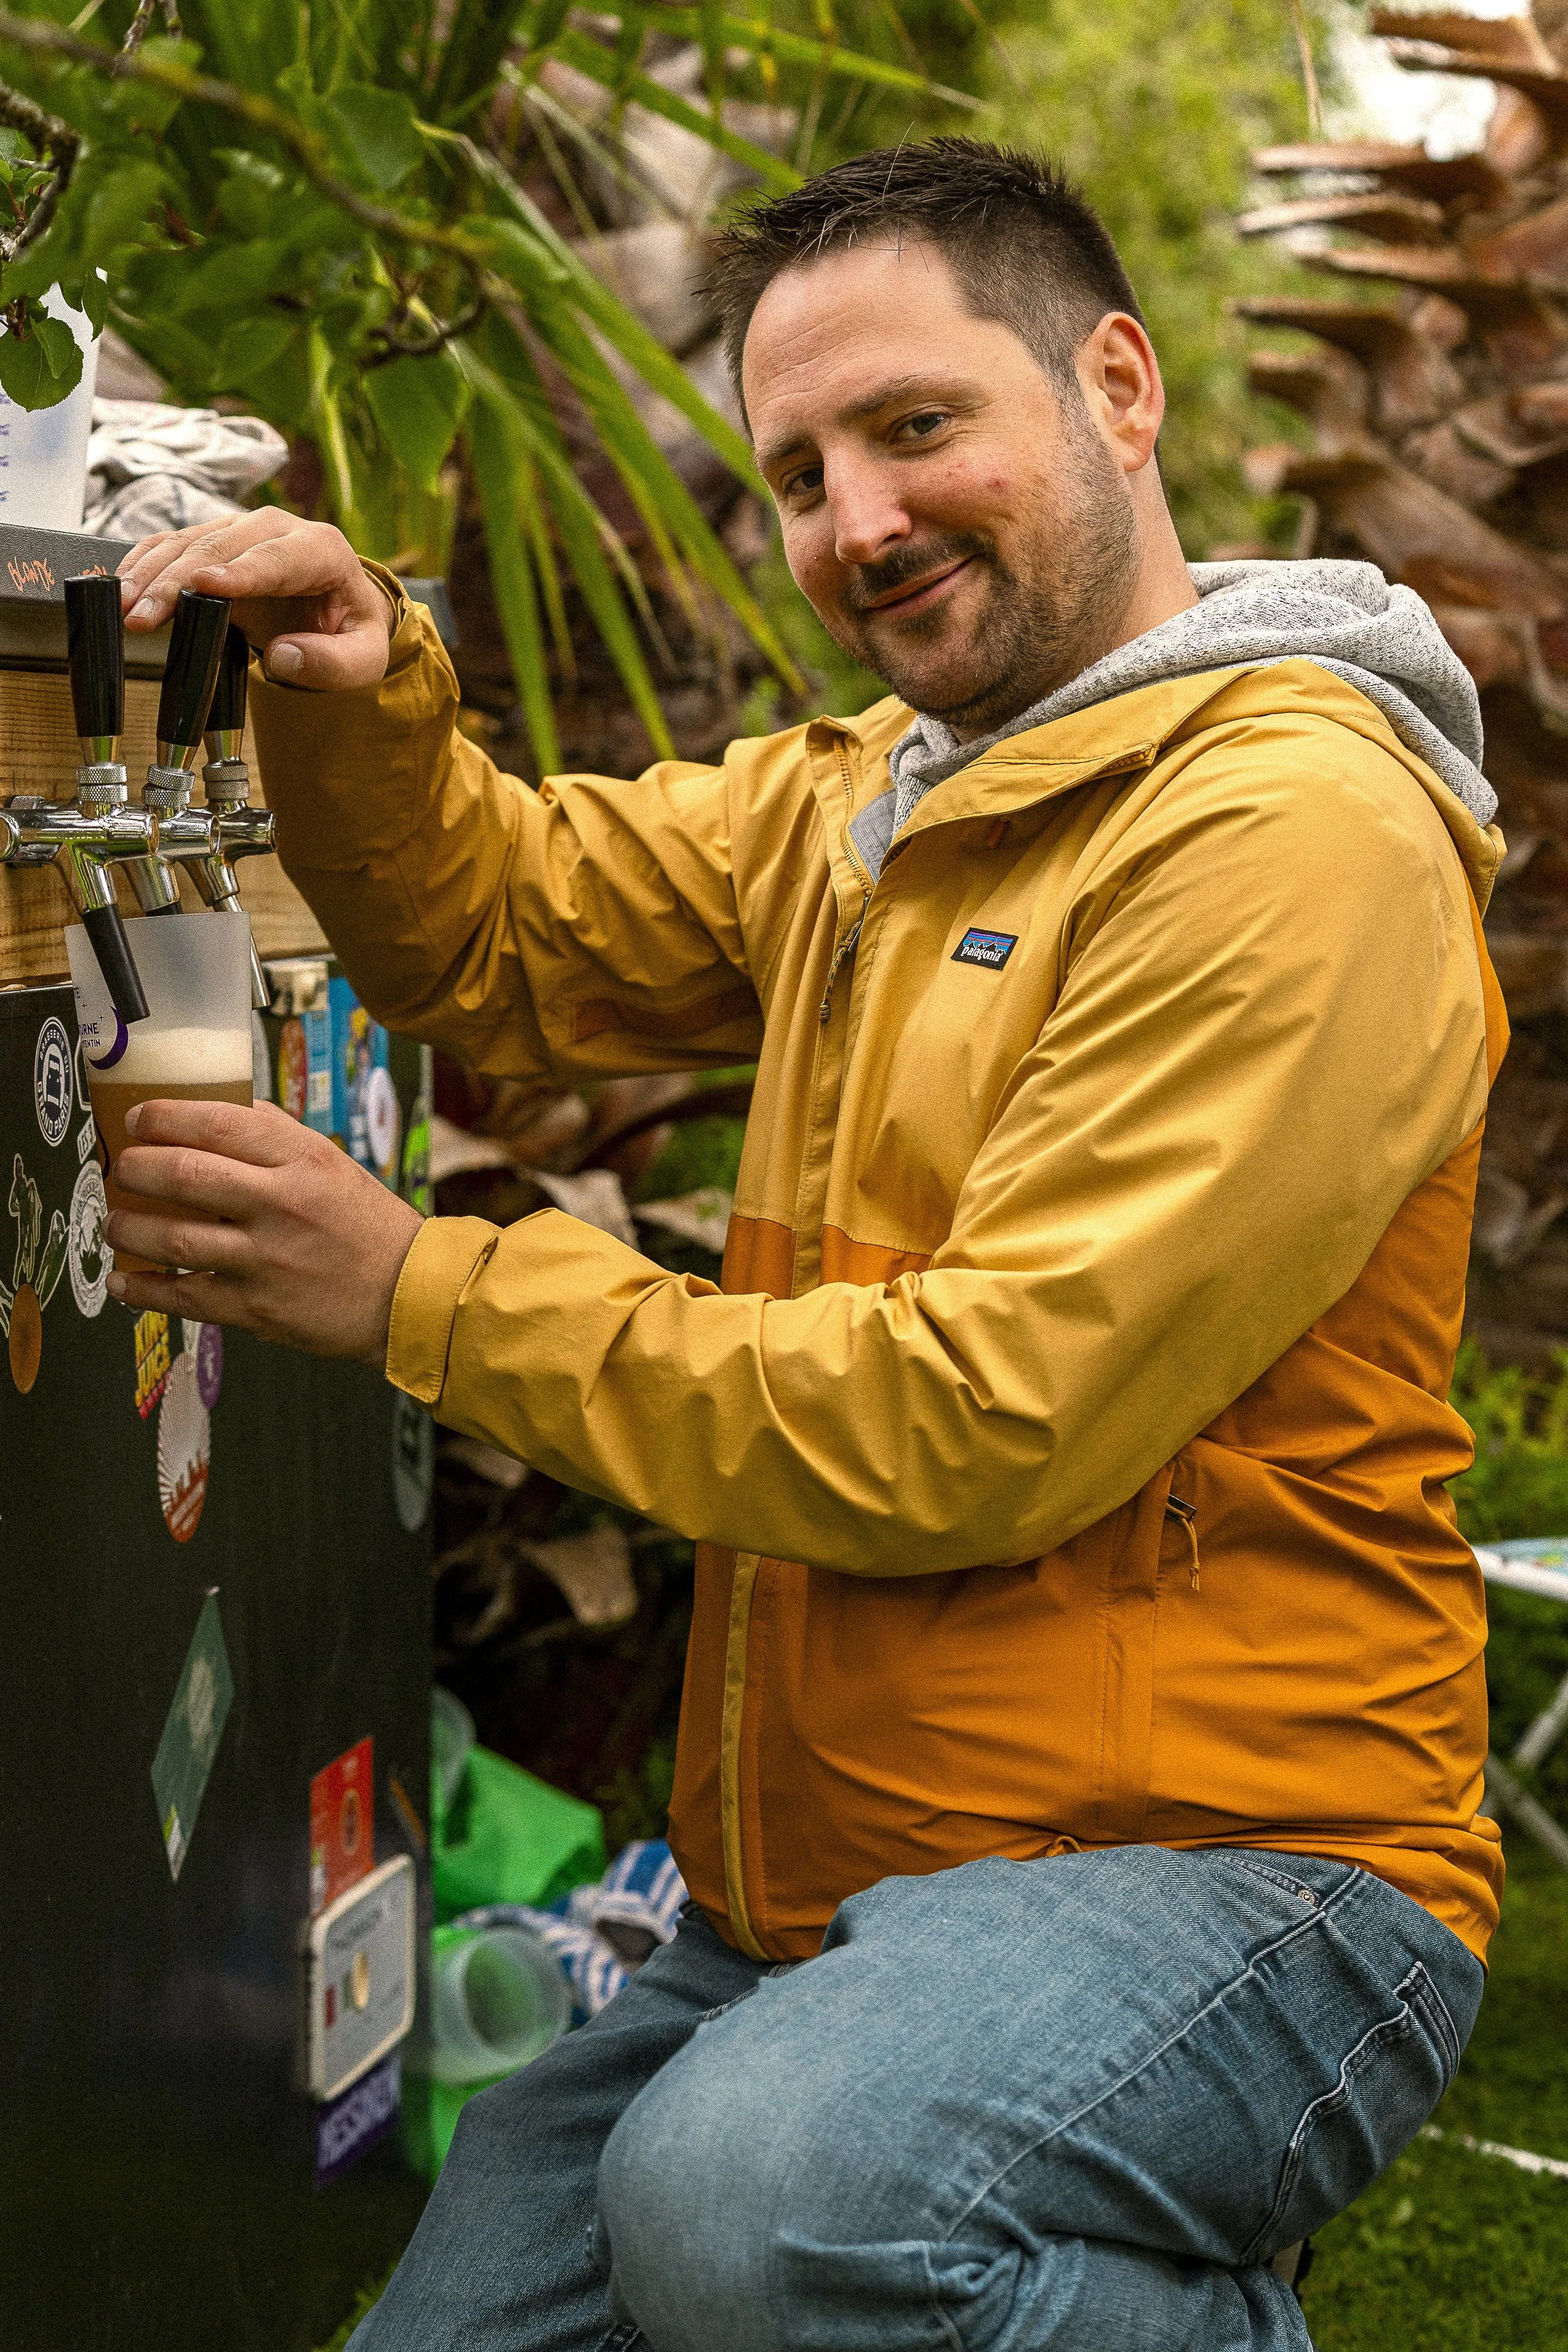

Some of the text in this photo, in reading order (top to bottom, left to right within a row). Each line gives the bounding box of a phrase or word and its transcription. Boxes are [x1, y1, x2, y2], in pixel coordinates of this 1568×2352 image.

[960, 946, 1002, 962] patagonia
[79, 1022, 99, 1036] URNE
[82, 1039, 101, 1049] TENTIN
[37, 1081, 69, 1135] GRAND PARIS
